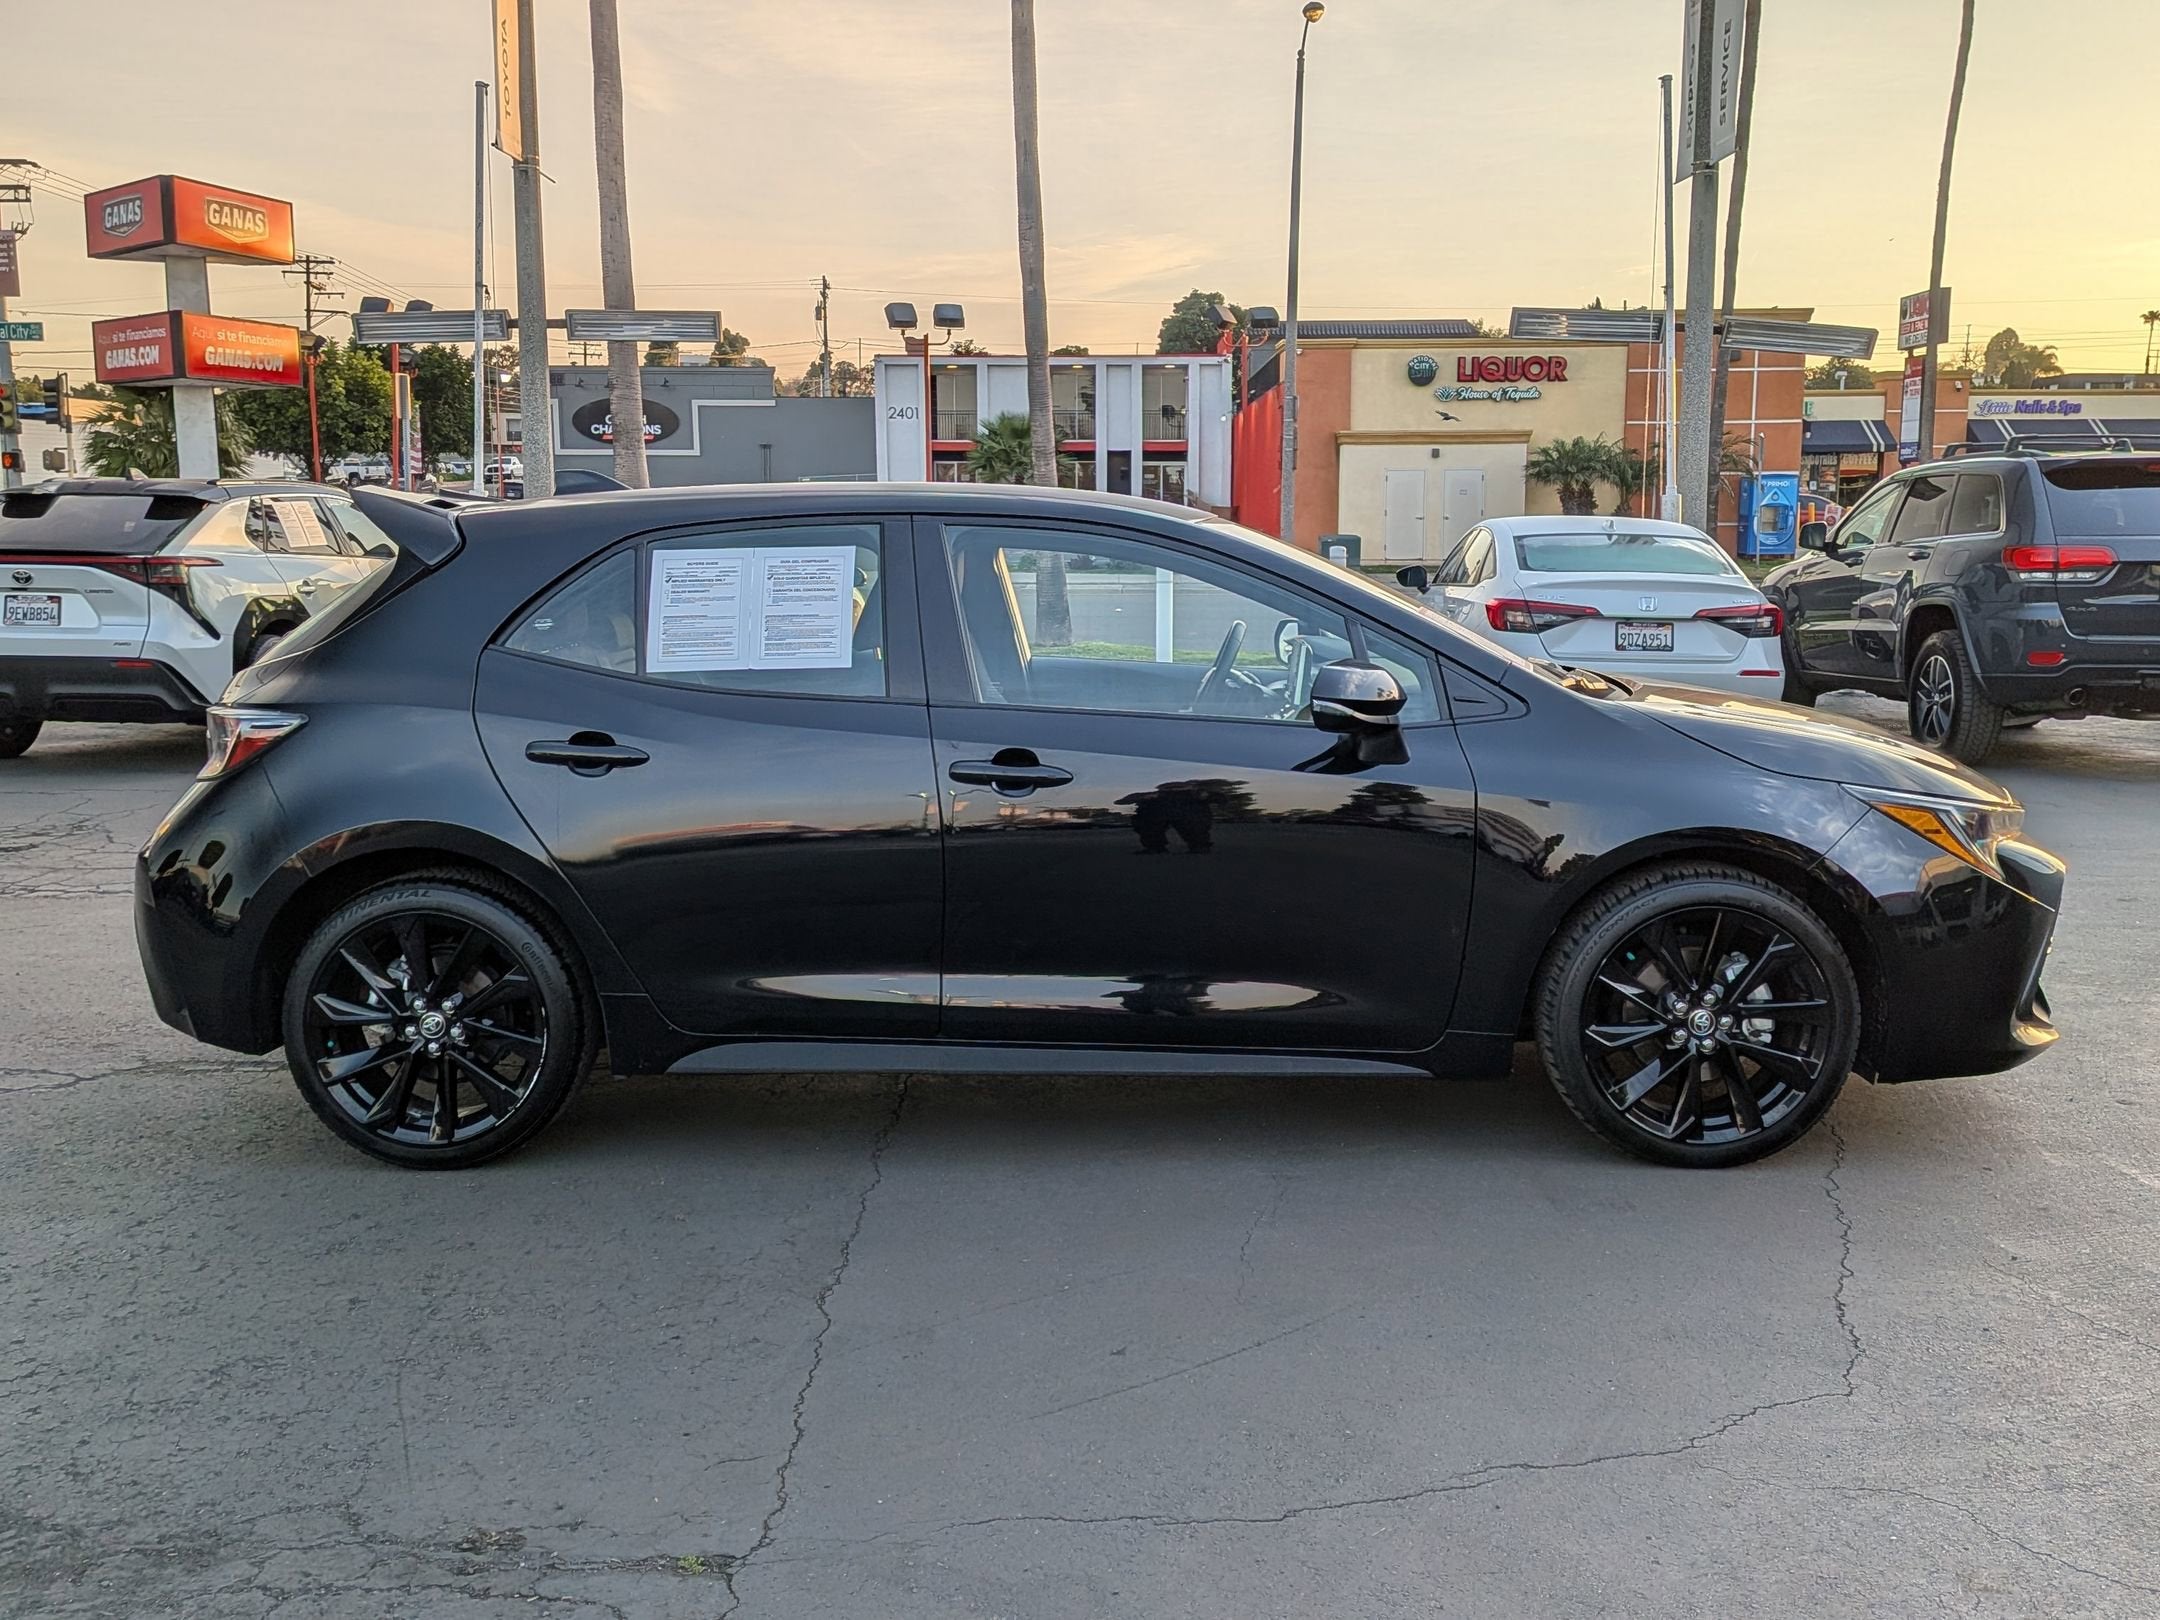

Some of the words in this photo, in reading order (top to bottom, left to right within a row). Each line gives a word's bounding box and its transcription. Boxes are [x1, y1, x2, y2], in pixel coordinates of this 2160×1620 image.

[500, 18, 511, 120] TOYOTA
[1719, 18, 1732, 127] SERVICE
[104, 199, 141, 229] GANAS
[208, 202, 266, 233] GANAS
[10, 324, 29, 340] City
[118, 331, 126, 342] te
[126, 327, 167, 342] financiamos
[226, 331, 238, 343] te
[105, 344, 160, 370] GANAS.COM
[205, 345, 284, 373] GANAS.COM
[1408, 355, 1439, 371] NATIONAL
[1414, 362, 1430, 370] CITY
[1457, 355, 1568, 382] LIQUOR
[1458, 387, 1490, 399] House
[1491, 387, 1502, 402] of
[1505, 386, 1541, 401] Tequila
[888, 406, 919, 420] 2401
[2014, 399, 2047, 414] Nails
[2047, 400, 2057, 414] &
[2057, 400, 2082, 416] Spa
[8, 606, 56, 621] 9EWB854
[1620, 632, 1668, 648] 9DZA951
